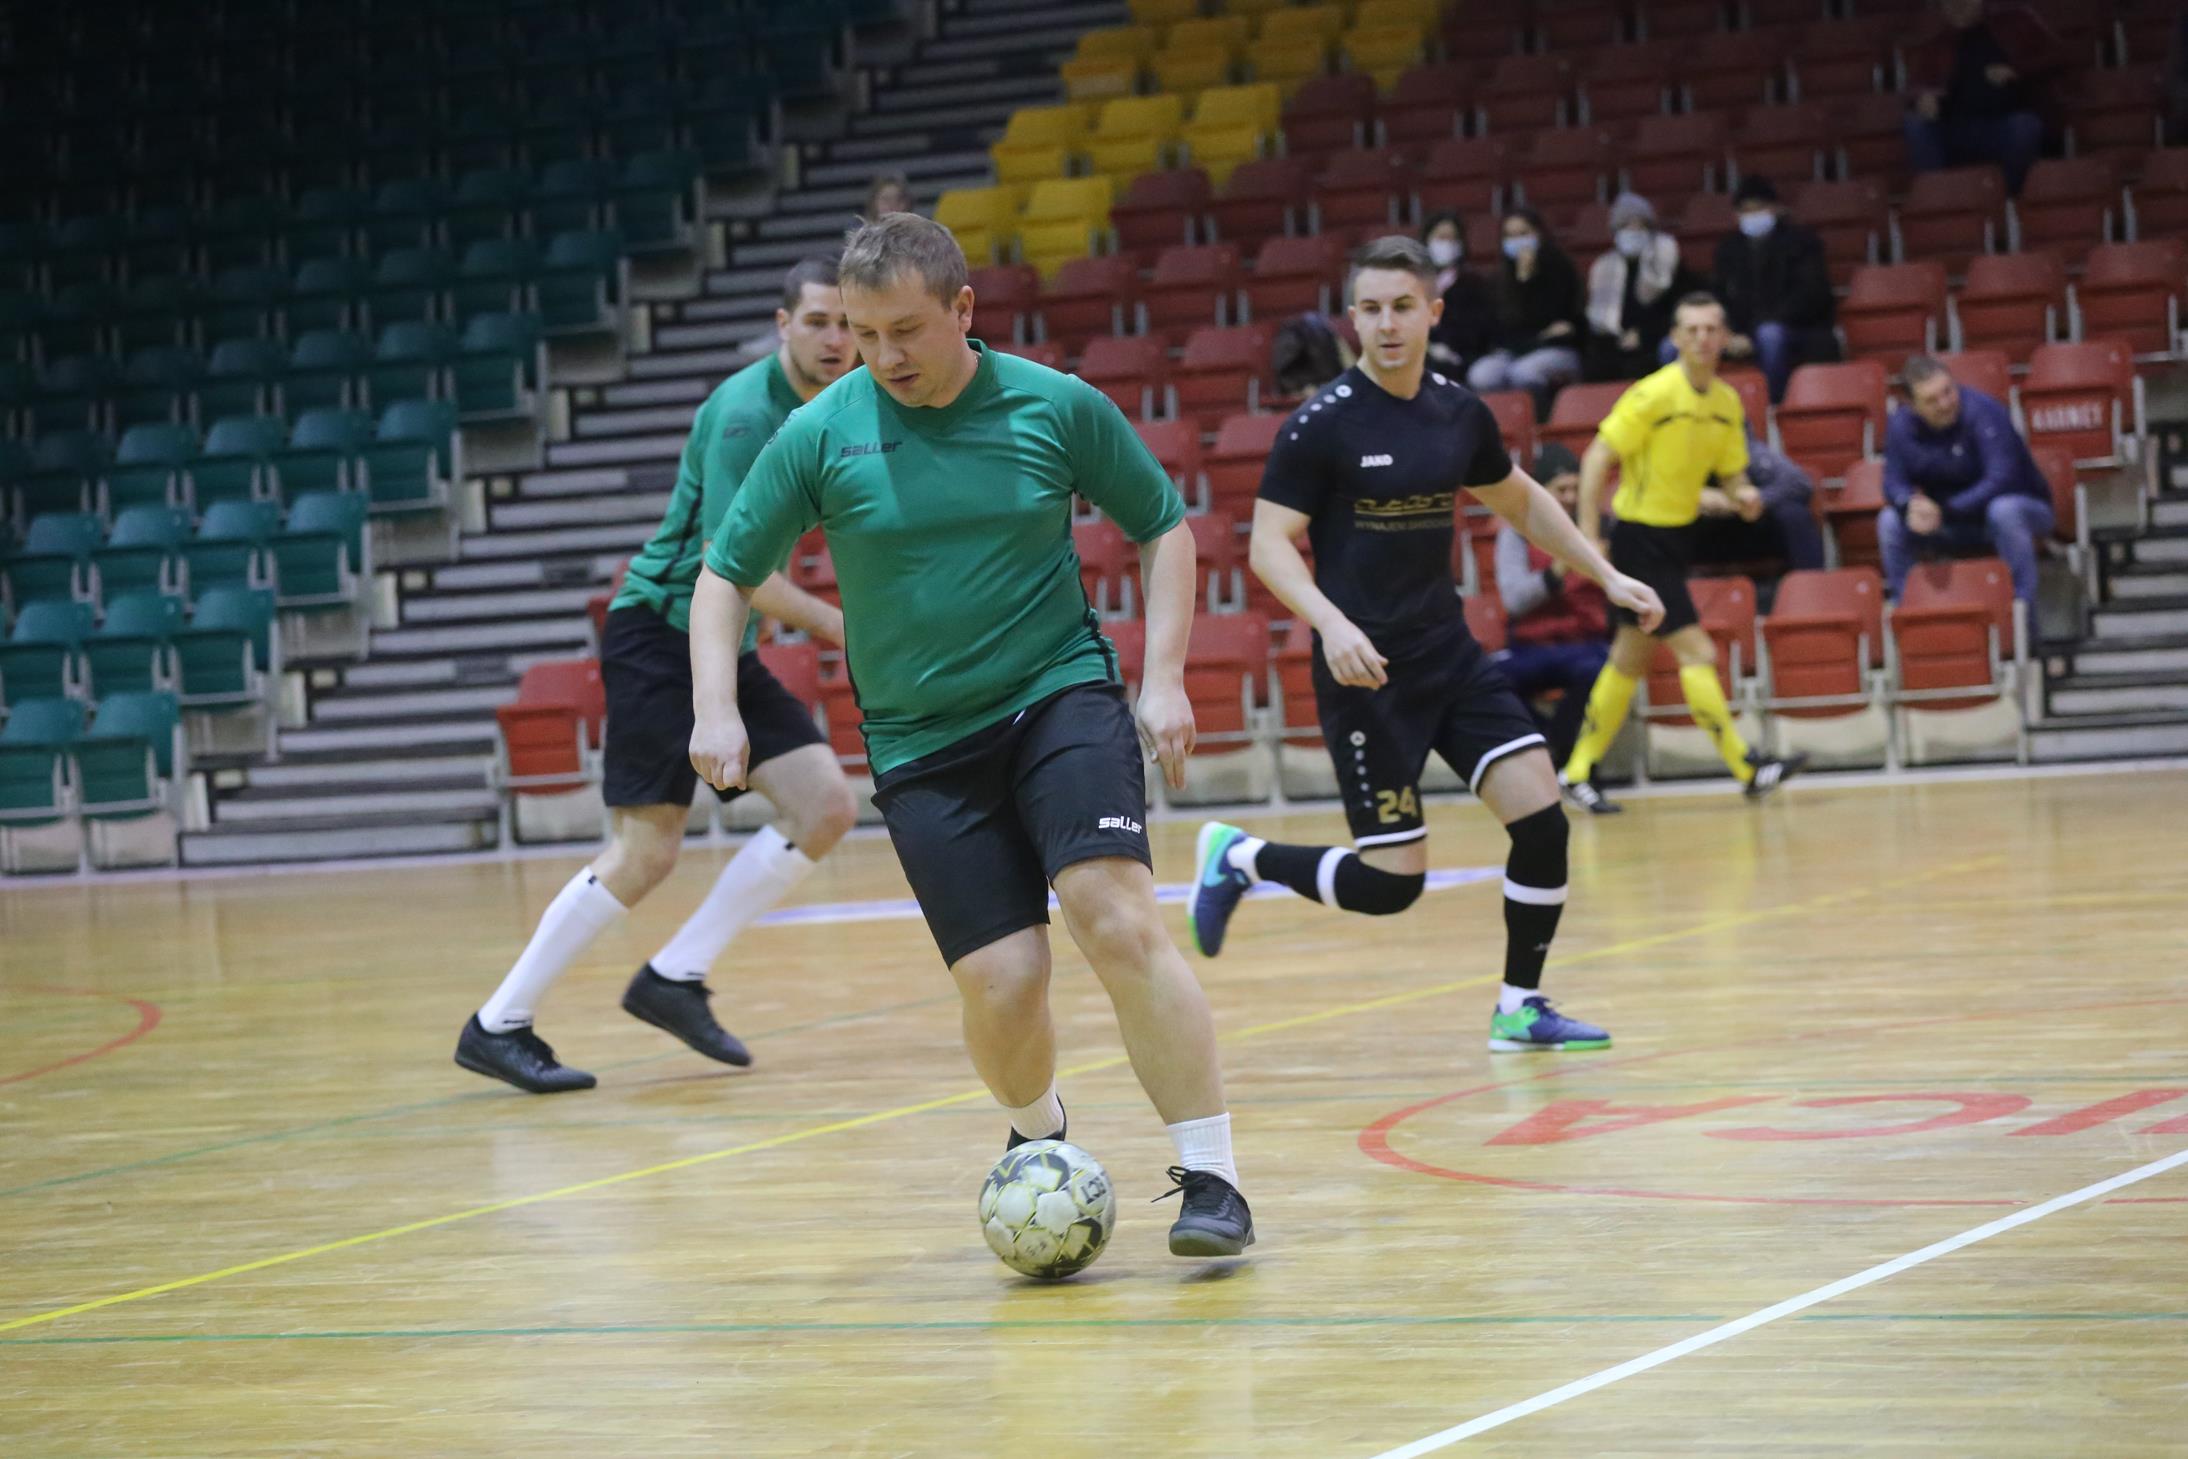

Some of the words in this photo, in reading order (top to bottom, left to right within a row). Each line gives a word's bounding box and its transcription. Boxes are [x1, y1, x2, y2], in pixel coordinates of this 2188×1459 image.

[1376, 786, 1418, 824] 24
[1098, 815, 1143, 834] saller
[1483, 1087, 2188, 1147] ICA
